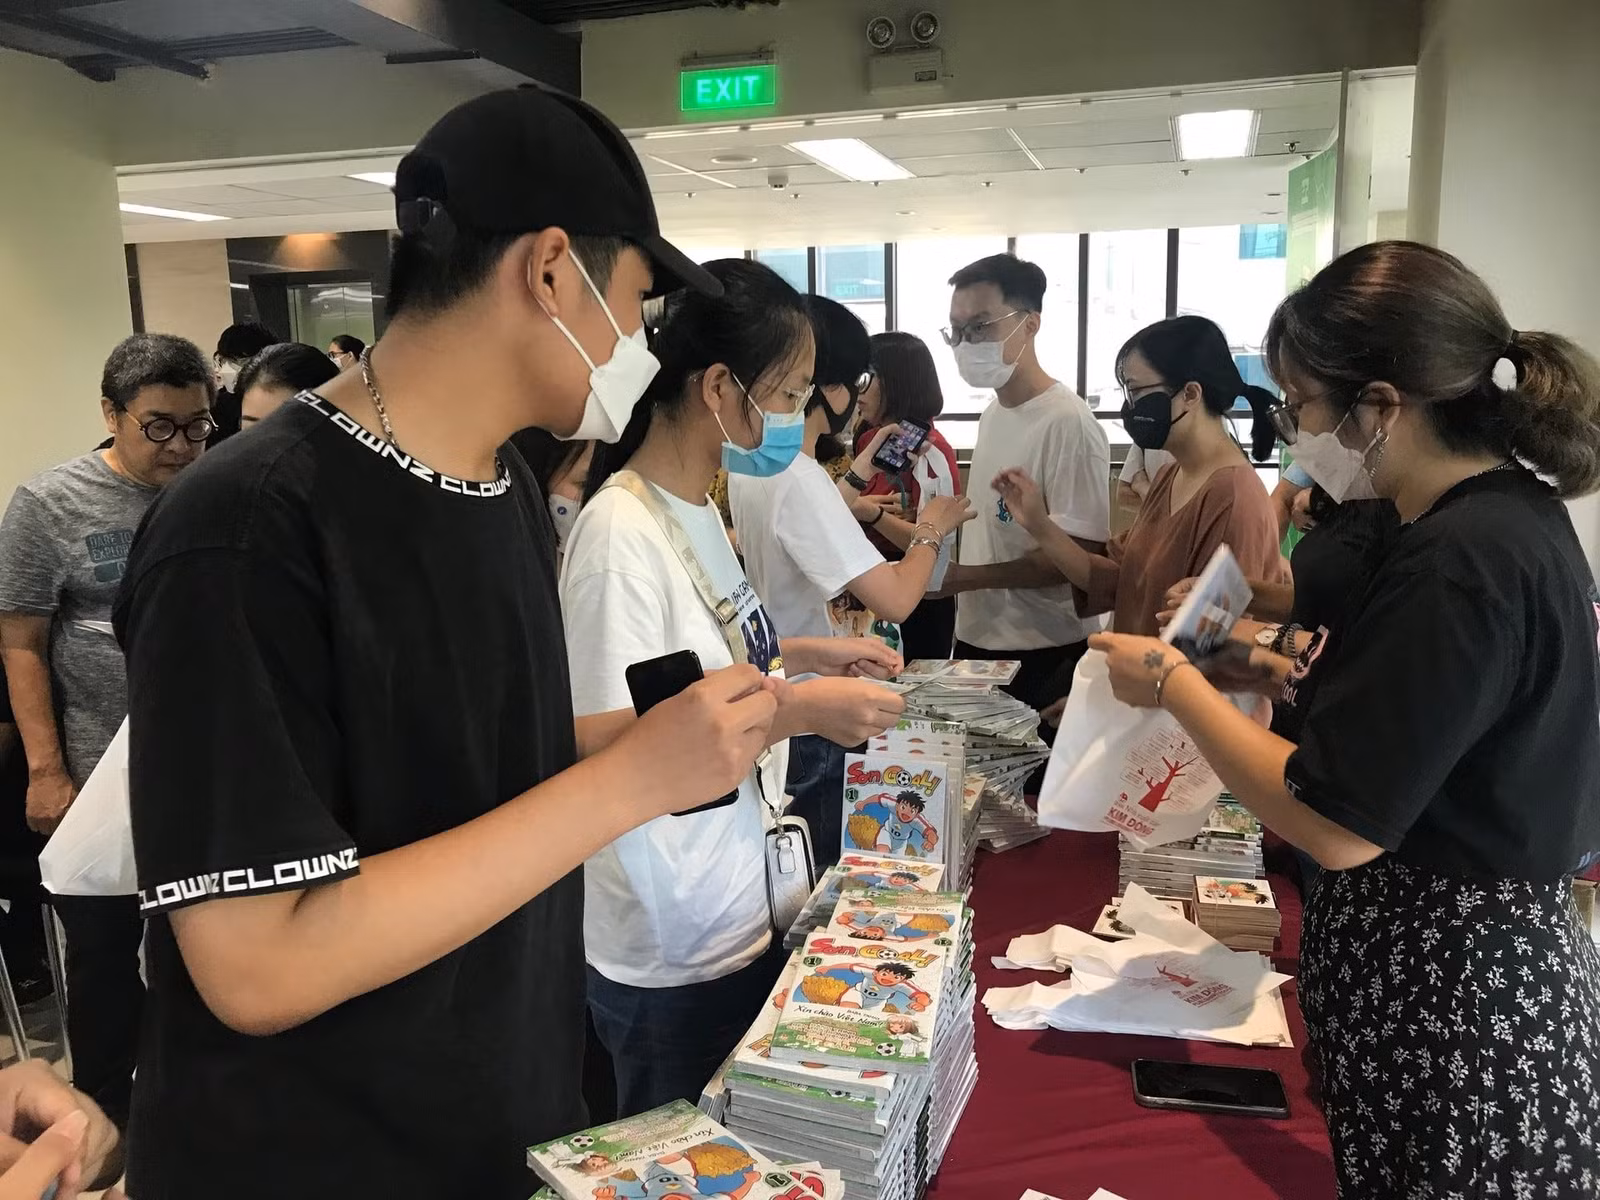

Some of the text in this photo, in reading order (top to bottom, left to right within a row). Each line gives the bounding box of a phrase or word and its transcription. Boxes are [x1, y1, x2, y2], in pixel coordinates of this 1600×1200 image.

[697, 74, 760, 103] EXIT
[1107, 806, 1129, 824] KIM
[223, 849, 359, 893] CLOWNZ
[863, 990, 878, 998] 10
[793, 1004, 812, 1014] Xin
[695, 1127, 715, 1138] Xin
